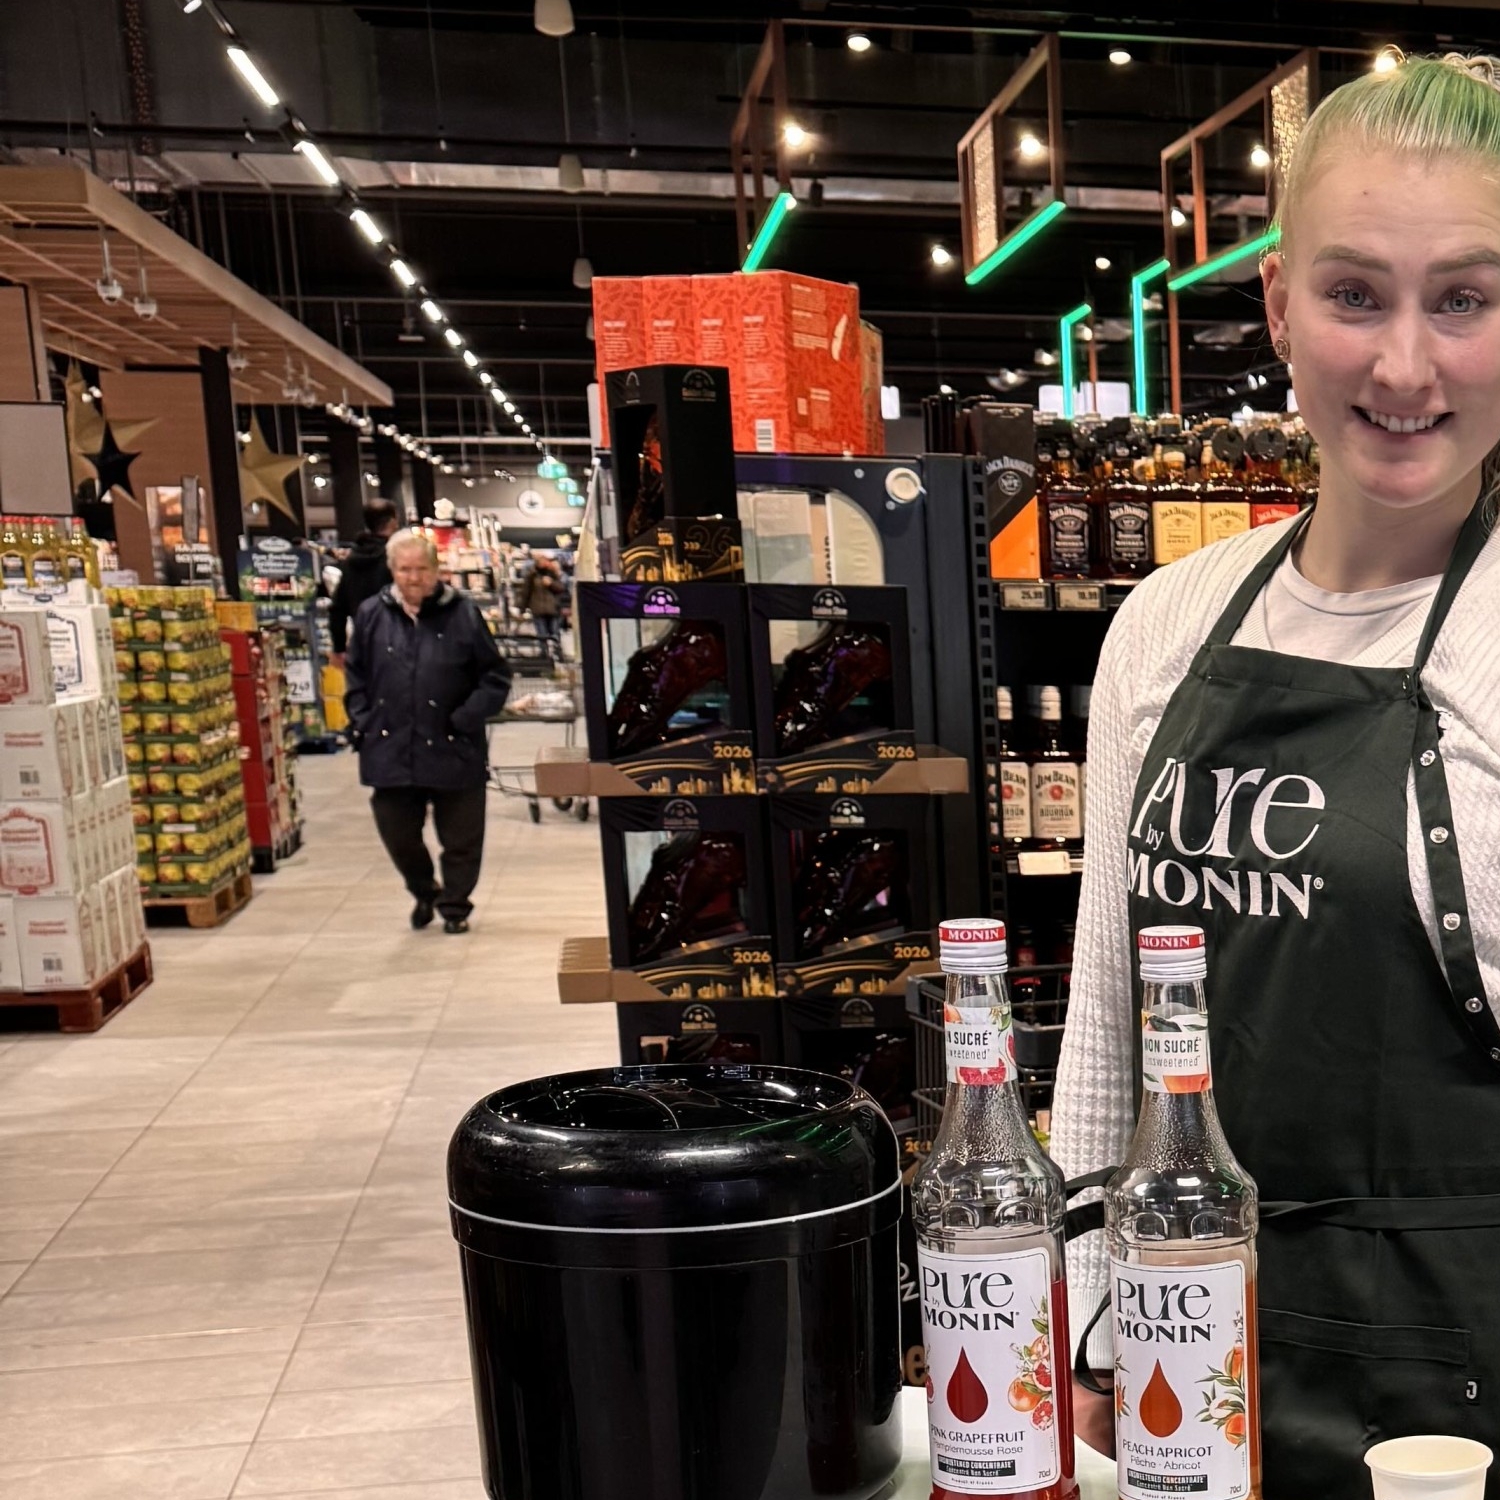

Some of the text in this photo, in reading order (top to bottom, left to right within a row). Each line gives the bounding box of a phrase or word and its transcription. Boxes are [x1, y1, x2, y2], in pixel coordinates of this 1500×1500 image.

[713, 743, 752, 758] 2026
[877, 744, 915, 758] 2026
[1131, 758, 1325, 859] Pure
[1146, 824, 1164, 850] by
[948, 929, 999, 941] MONIN
[1140, 936, 1191, 948] MONIN
[733, 951, 772, 964] 2026
[894, 946, 931, 959] 2026
[922, 1266, 1014, 1309] Pure
[1117, 1277, 1211, 1321] Pure
[925, 1308, 1015, 1331] MONIN
[1117, 1320, 1212, 1343] MONIN
[931, 1424, 1025, 1443] PINK GRAPEFRUIT
[1123, 1439, 1213, 1458] PEACH APRICOT
[1131, 1455, 1200, 1470] Pêche Abricot
[1230, 1485, 1241, 1494] 70cl
